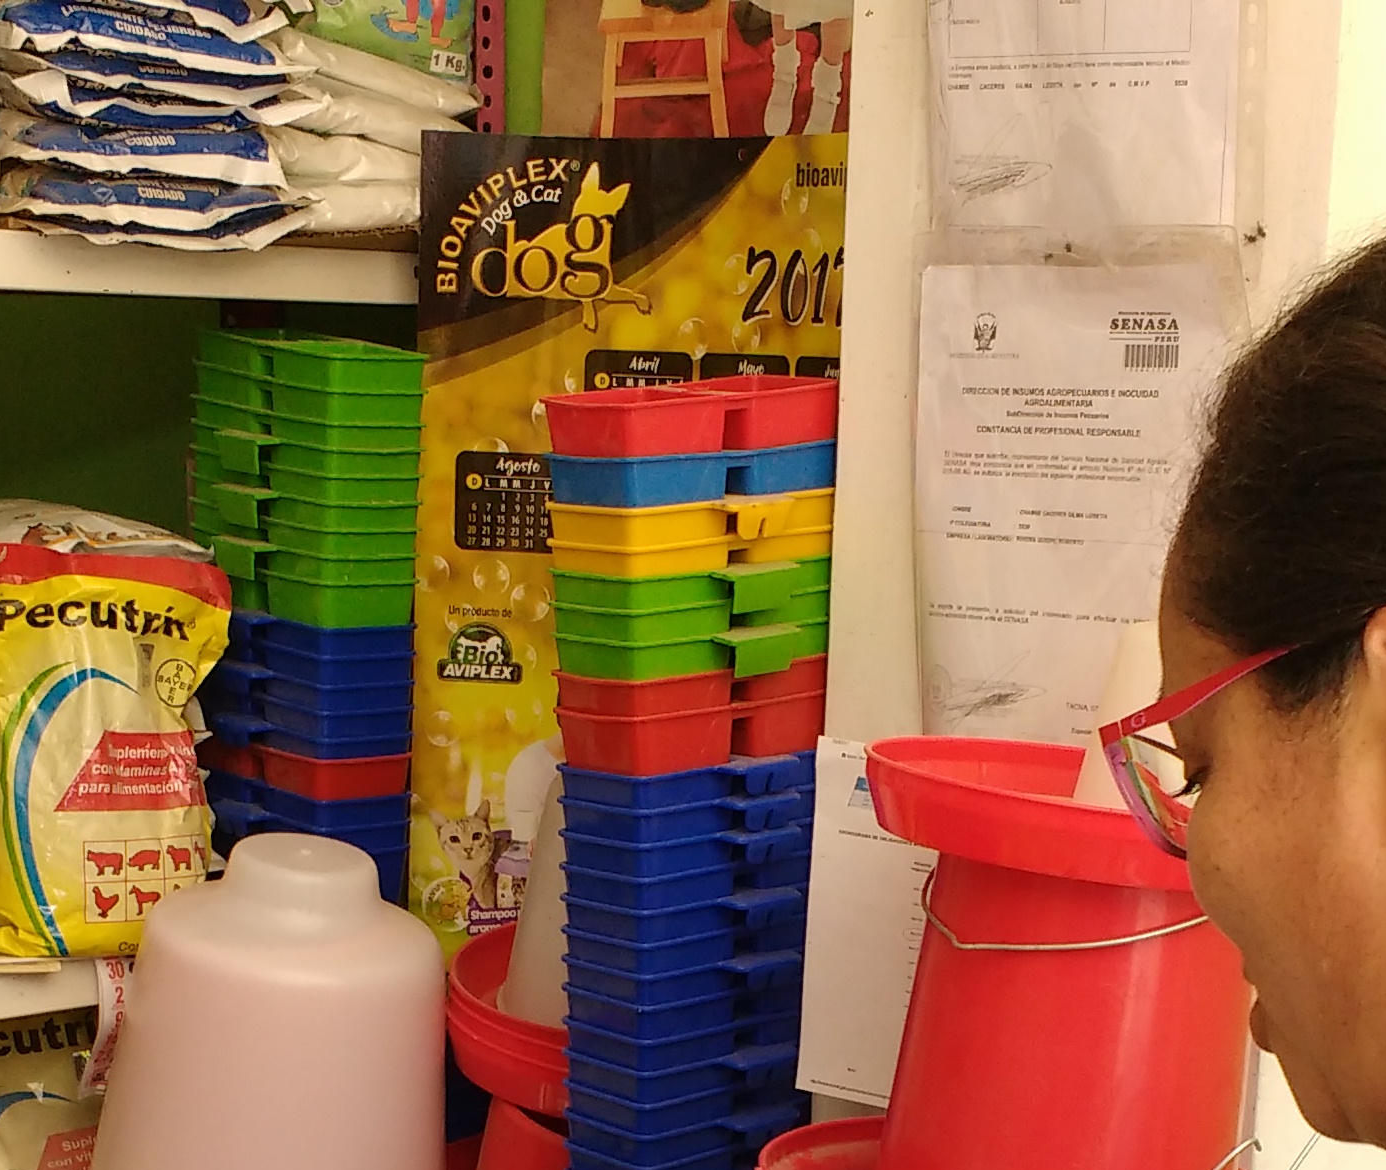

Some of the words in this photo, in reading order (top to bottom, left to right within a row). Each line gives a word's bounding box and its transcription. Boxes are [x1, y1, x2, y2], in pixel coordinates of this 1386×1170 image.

[114, 21, 166, 41] CUIDADO
[125, 133, 176, 147] CUIDADO
[136, 187, 185, 202] CUIDADO
[481, 202, 512, 236] Dog
[531, 185, 562, 202] Cat
[436, 157, 570, 294] BIOAVIPLEX
[1110, 318, 1179, 331] SENASA
[629, 356, 660, 374] Abril
[738, 360, 764, 375] Mayo
[496, 457, 541, 477] Agosto
[449, 605, 460, 615] Un
[462, 606, 500, 618] producto
[502, 608, 512, 618] de
[463, 645, 499, 664] Bio
[443, 663, 513, 680] AVIPLEX
[470, 909, 516, 921] Shampoo
[47, 1158, 72, 1168] con
